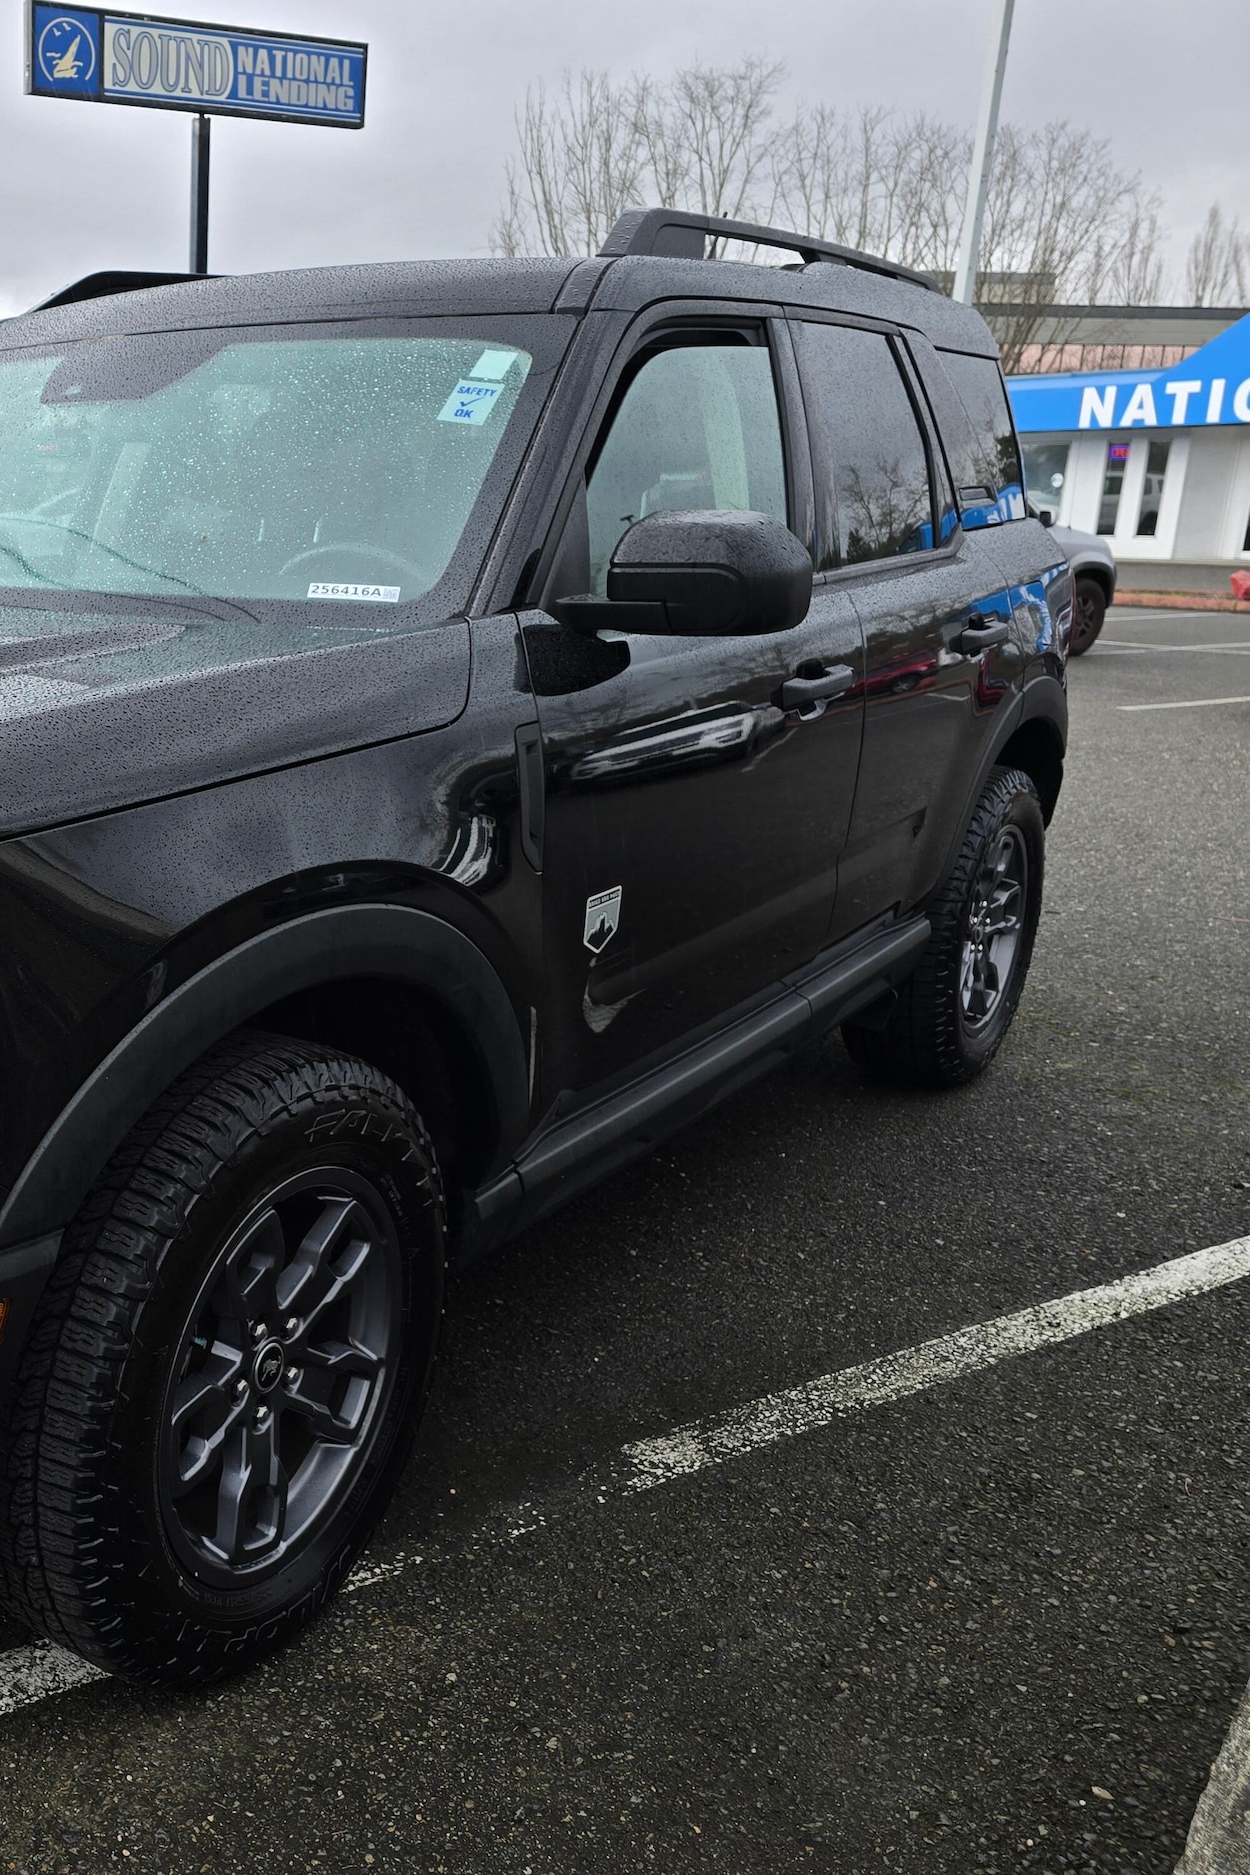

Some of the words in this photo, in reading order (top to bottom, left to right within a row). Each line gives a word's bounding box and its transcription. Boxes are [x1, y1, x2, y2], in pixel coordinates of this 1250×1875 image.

[111, 27, 231, 96] SOUND
[237, 46, 354, 86] NATIONAL
[237, 73, 355, 111] LENDING
[456, 386, 498, 398] SAFETY
[454, 408, 474, 419] OK
[311, 584, 381, 597] 256416A
